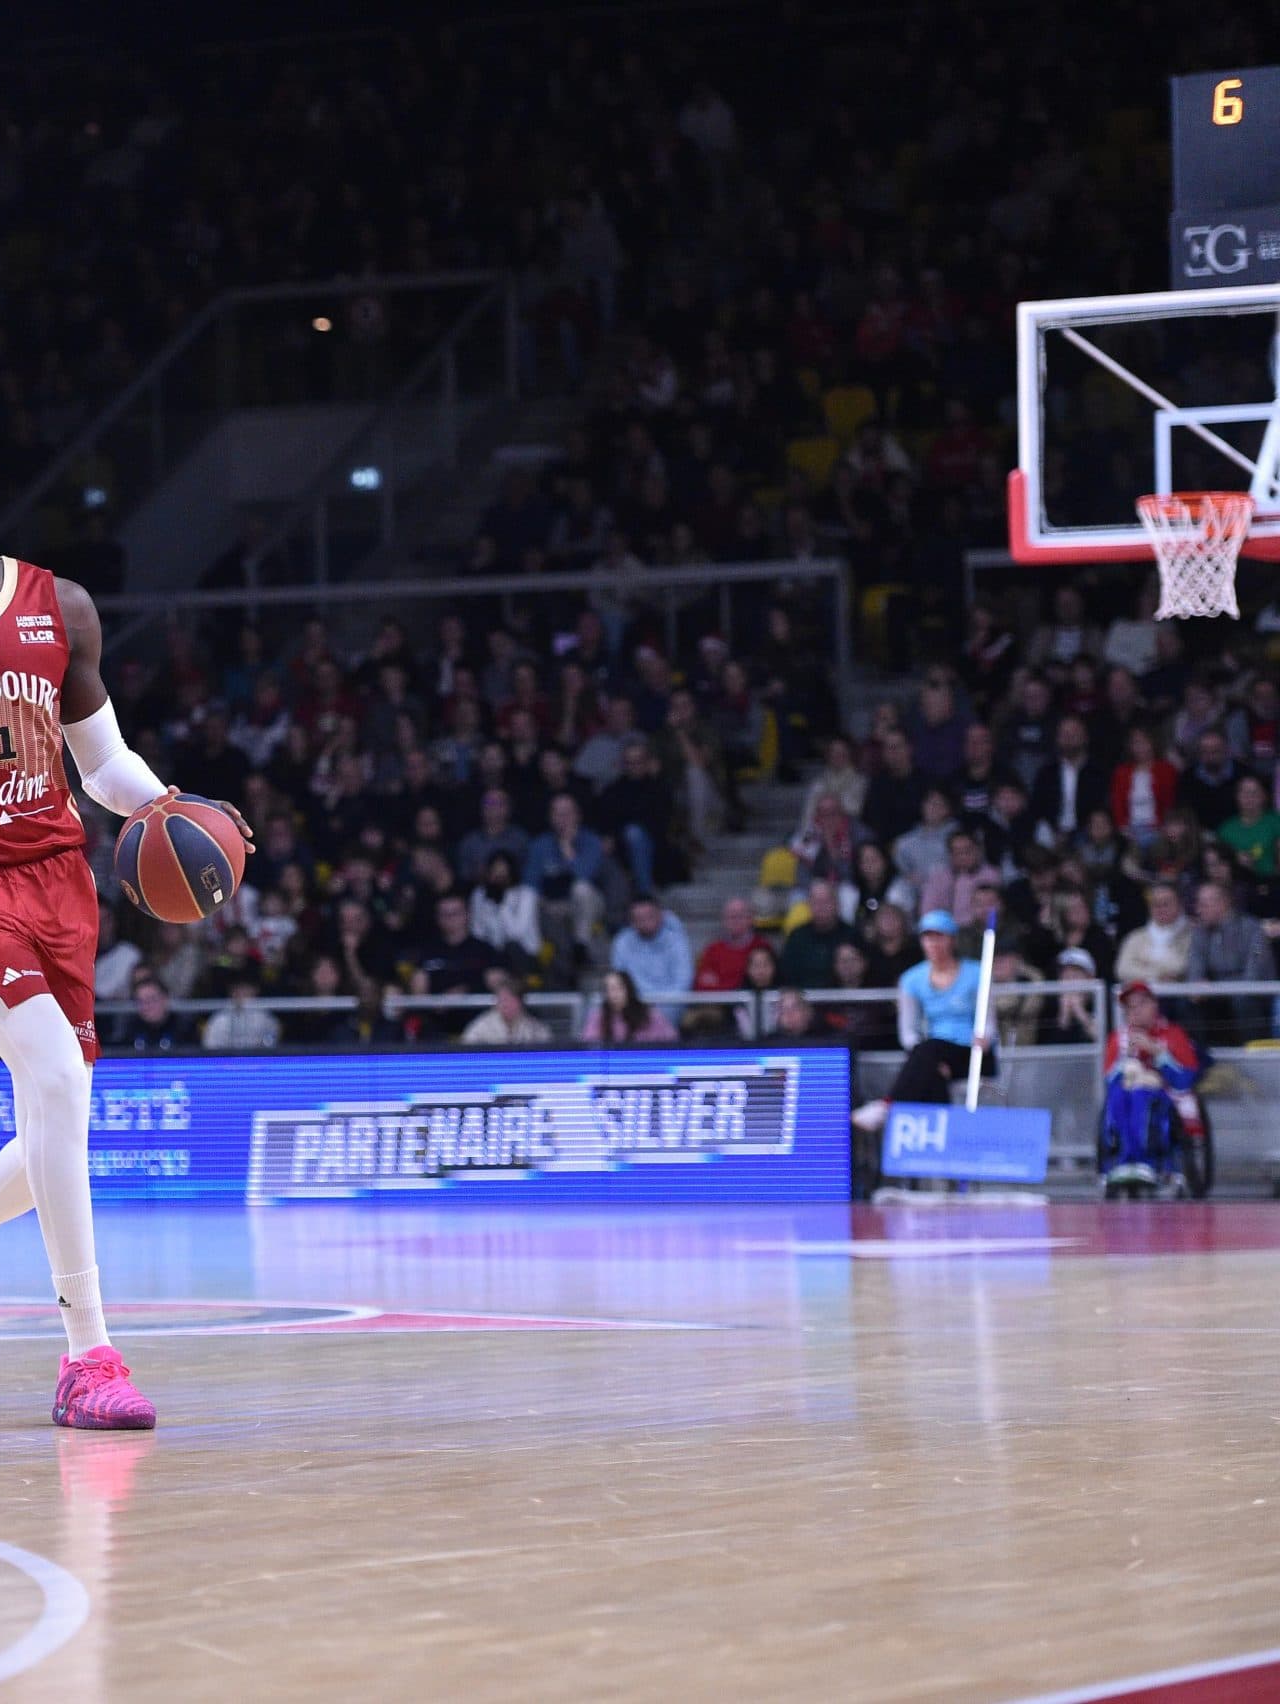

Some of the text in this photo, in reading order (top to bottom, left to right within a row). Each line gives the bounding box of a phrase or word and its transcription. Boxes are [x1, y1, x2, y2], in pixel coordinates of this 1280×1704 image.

[1212, 78, 1243, 126] 6
[29, 630, 55, 641] LCR
[291, 1081, 749, 1183] PARTENAIRE SILVER
[890, 1108, 948, 1159] RH
